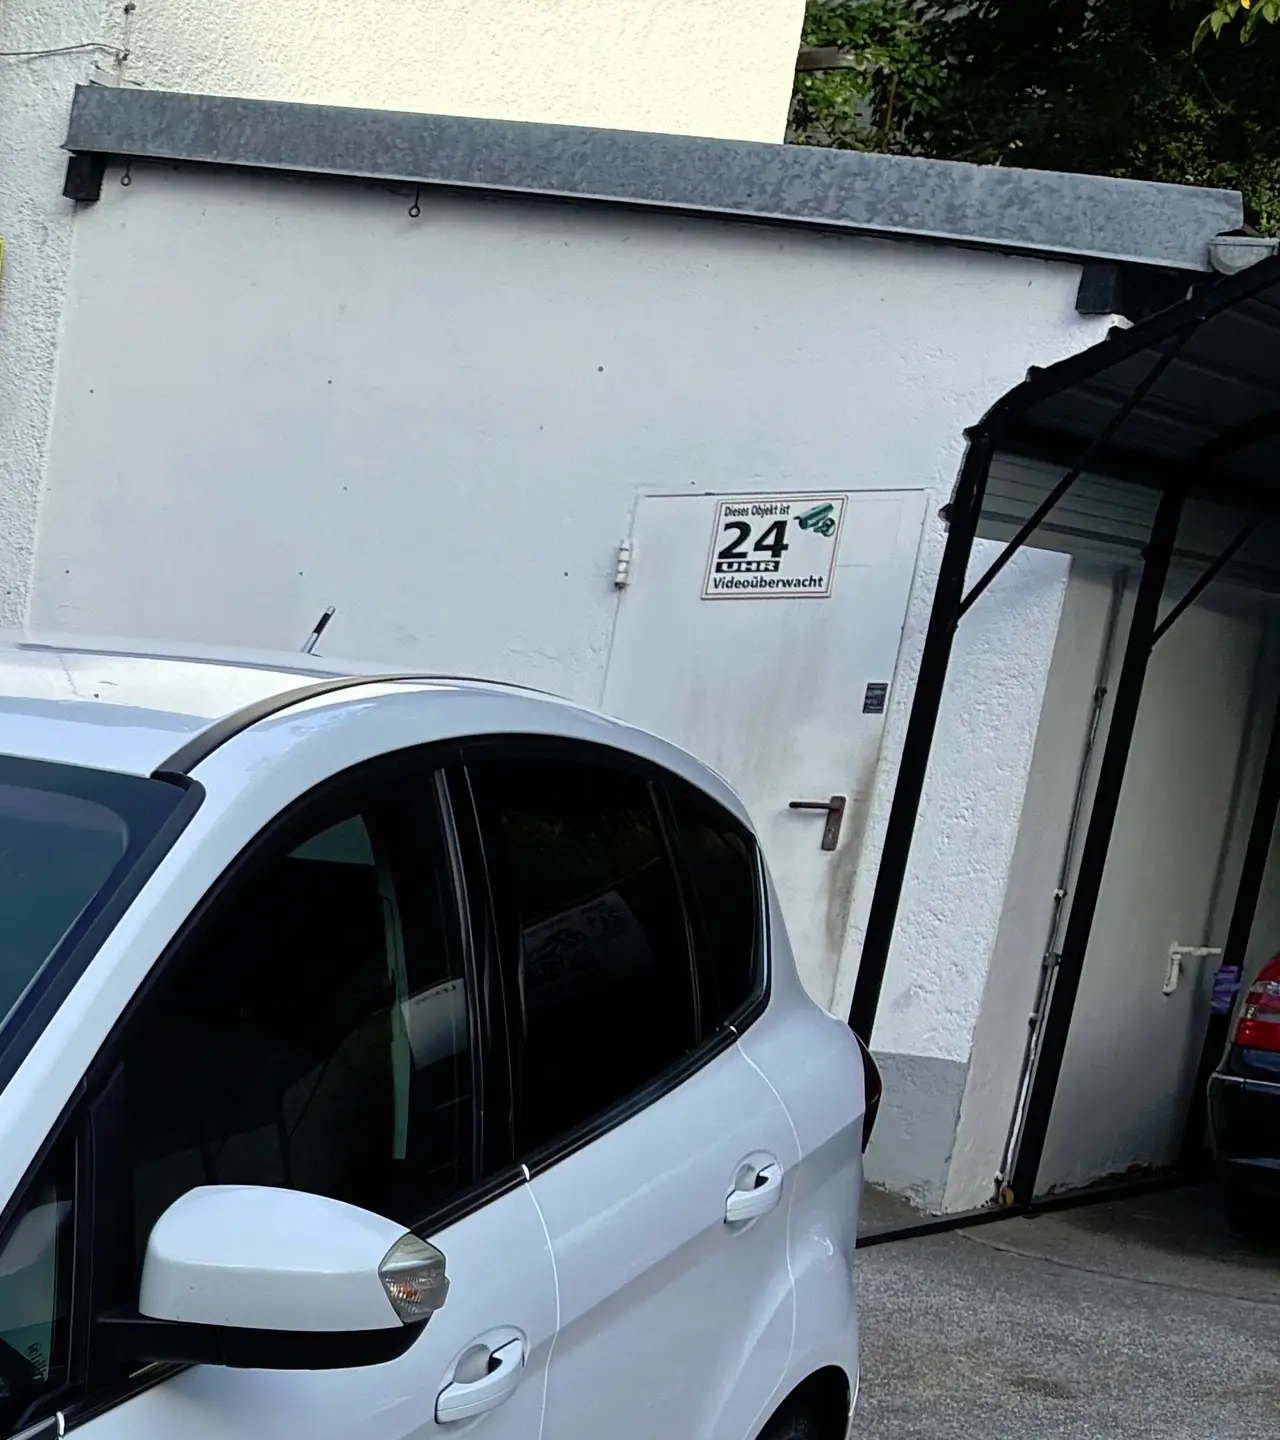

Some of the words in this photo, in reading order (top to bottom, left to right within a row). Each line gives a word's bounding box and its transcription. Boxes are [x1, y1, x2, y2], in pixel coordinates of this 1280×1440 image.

[724, 505, 750, 517] Dieses
[750, 504, 778, 518] Objekt
[779, 504, 791, 516] ist
[717, 519, 790, 560] 24
[720, 561, 777, 572] UHR
[713, 575, 824, 590] Videoüberwacht
